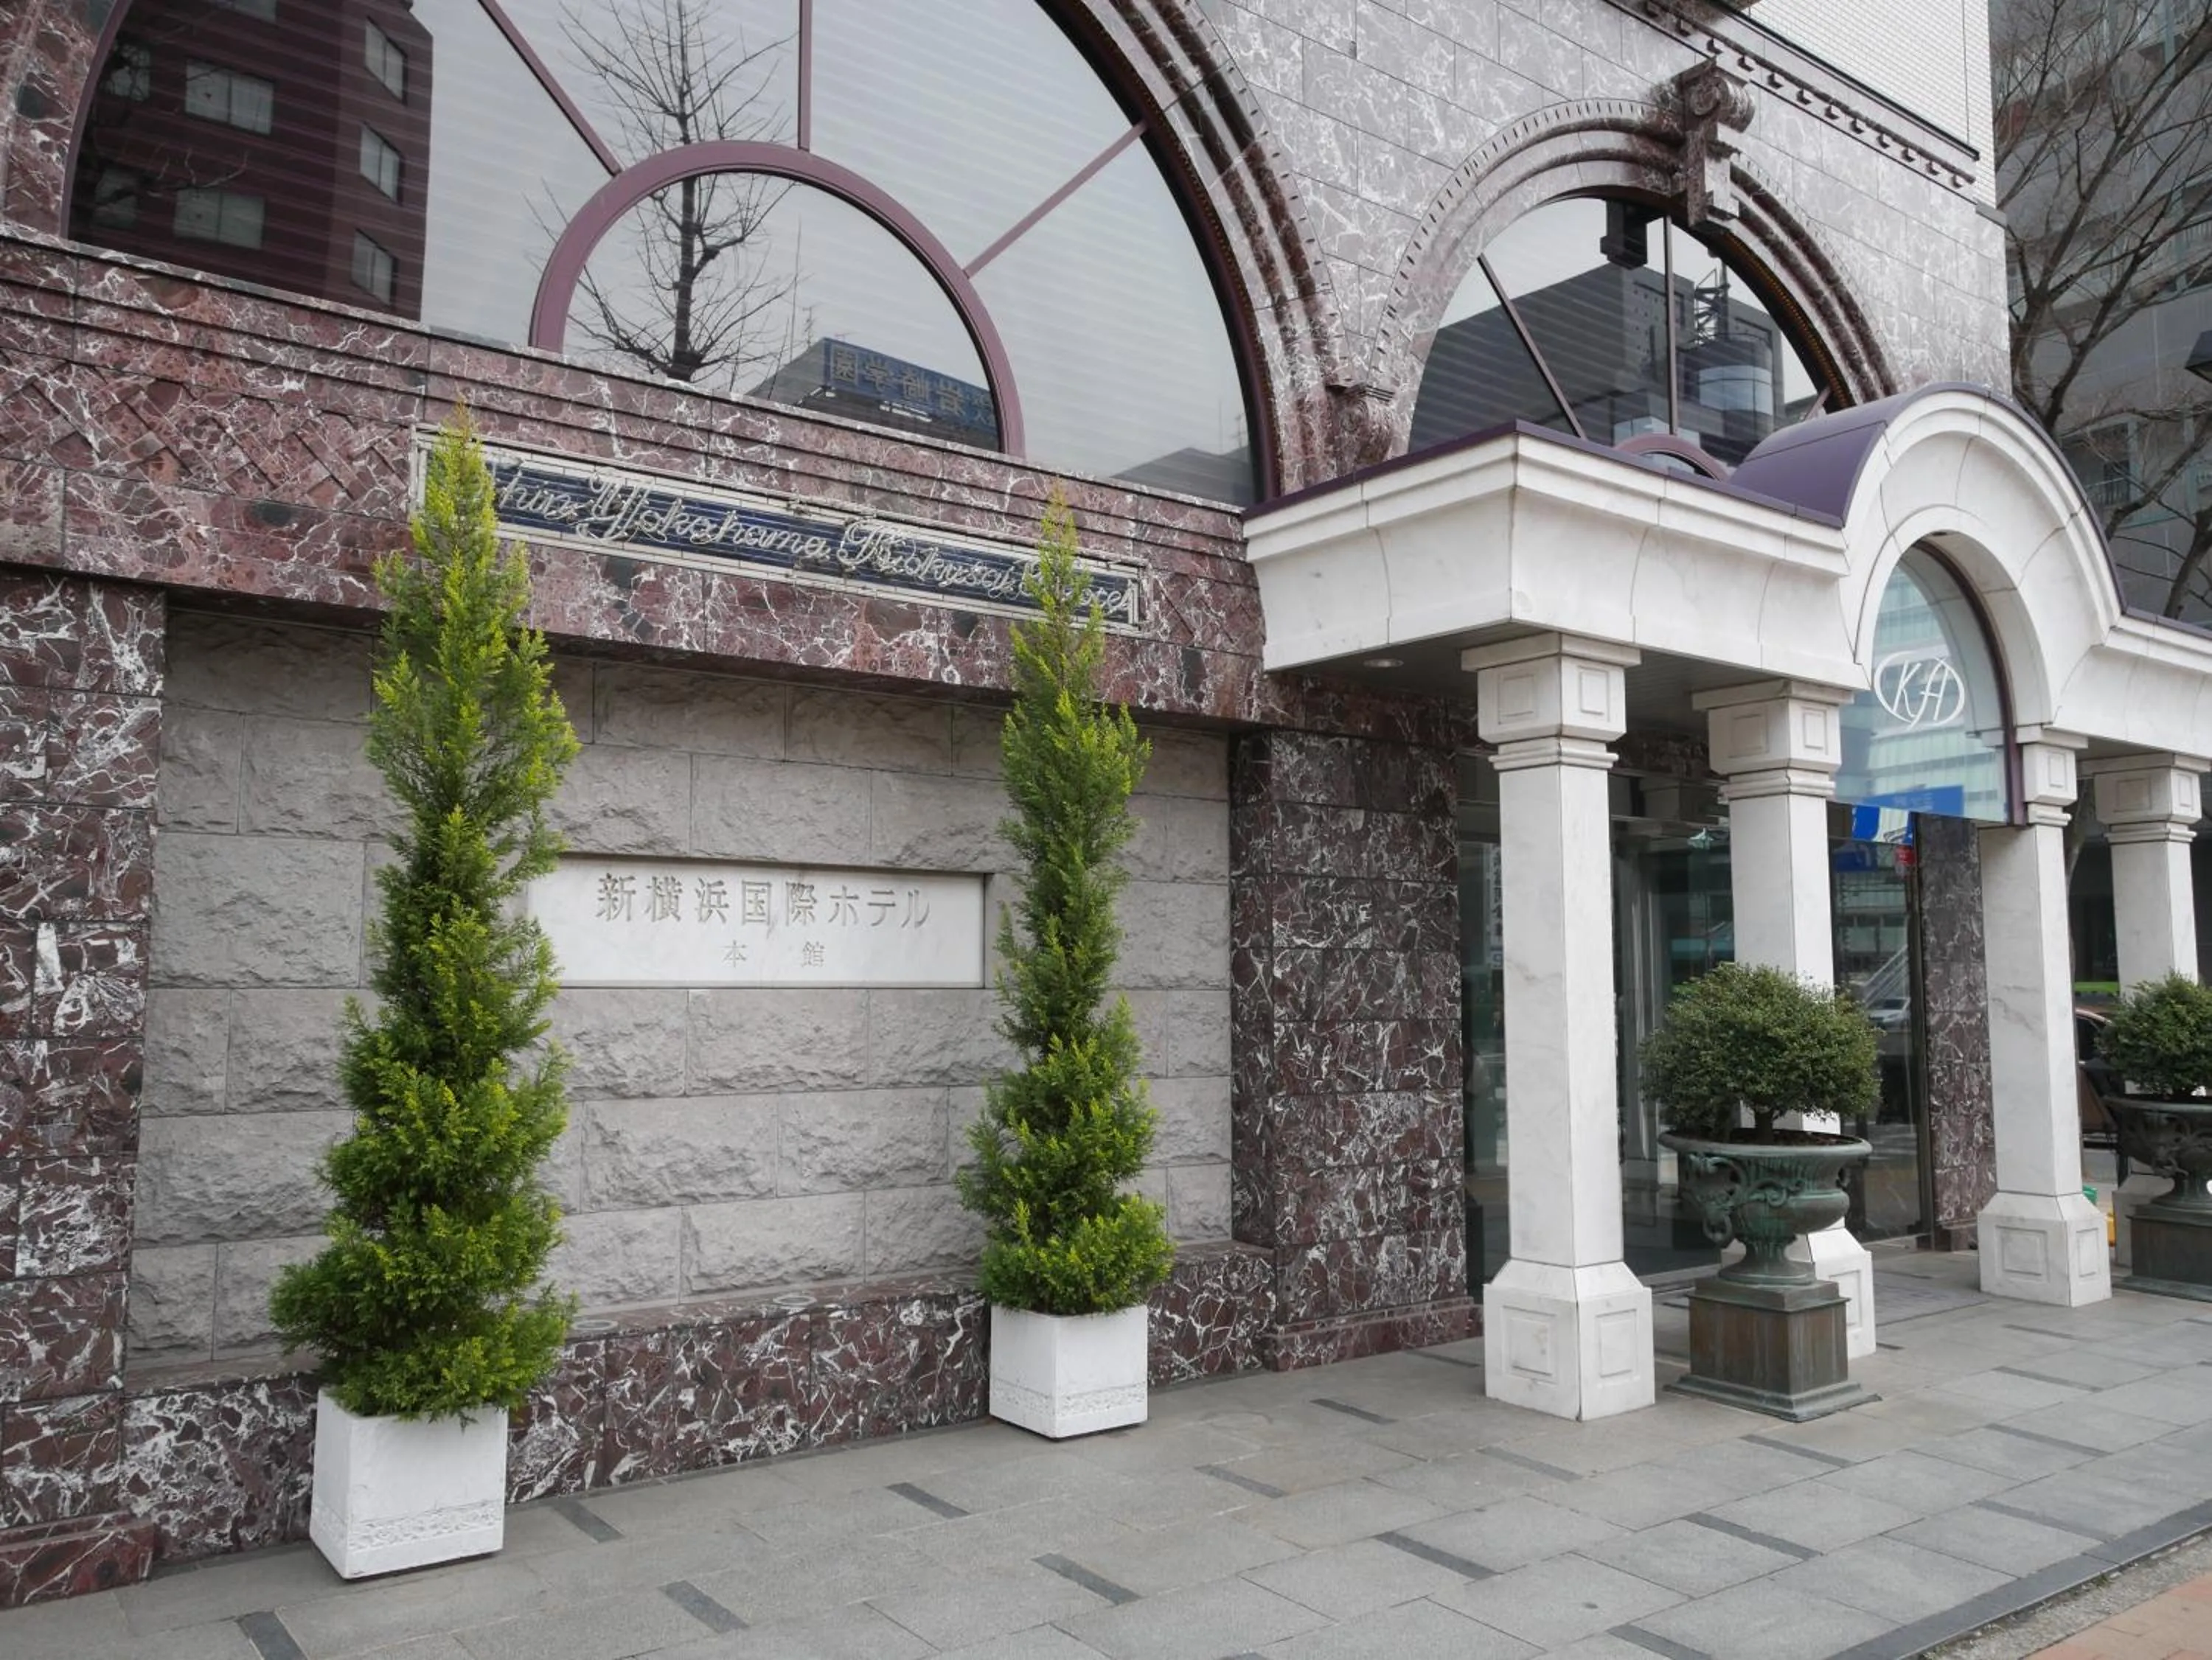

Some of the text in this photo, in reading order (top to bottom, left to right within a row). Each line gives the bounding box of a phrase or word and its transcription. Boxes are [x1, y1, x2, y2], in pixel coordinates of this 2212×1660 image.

[597, 872, 931, 927] 新横浜国際ホテル
